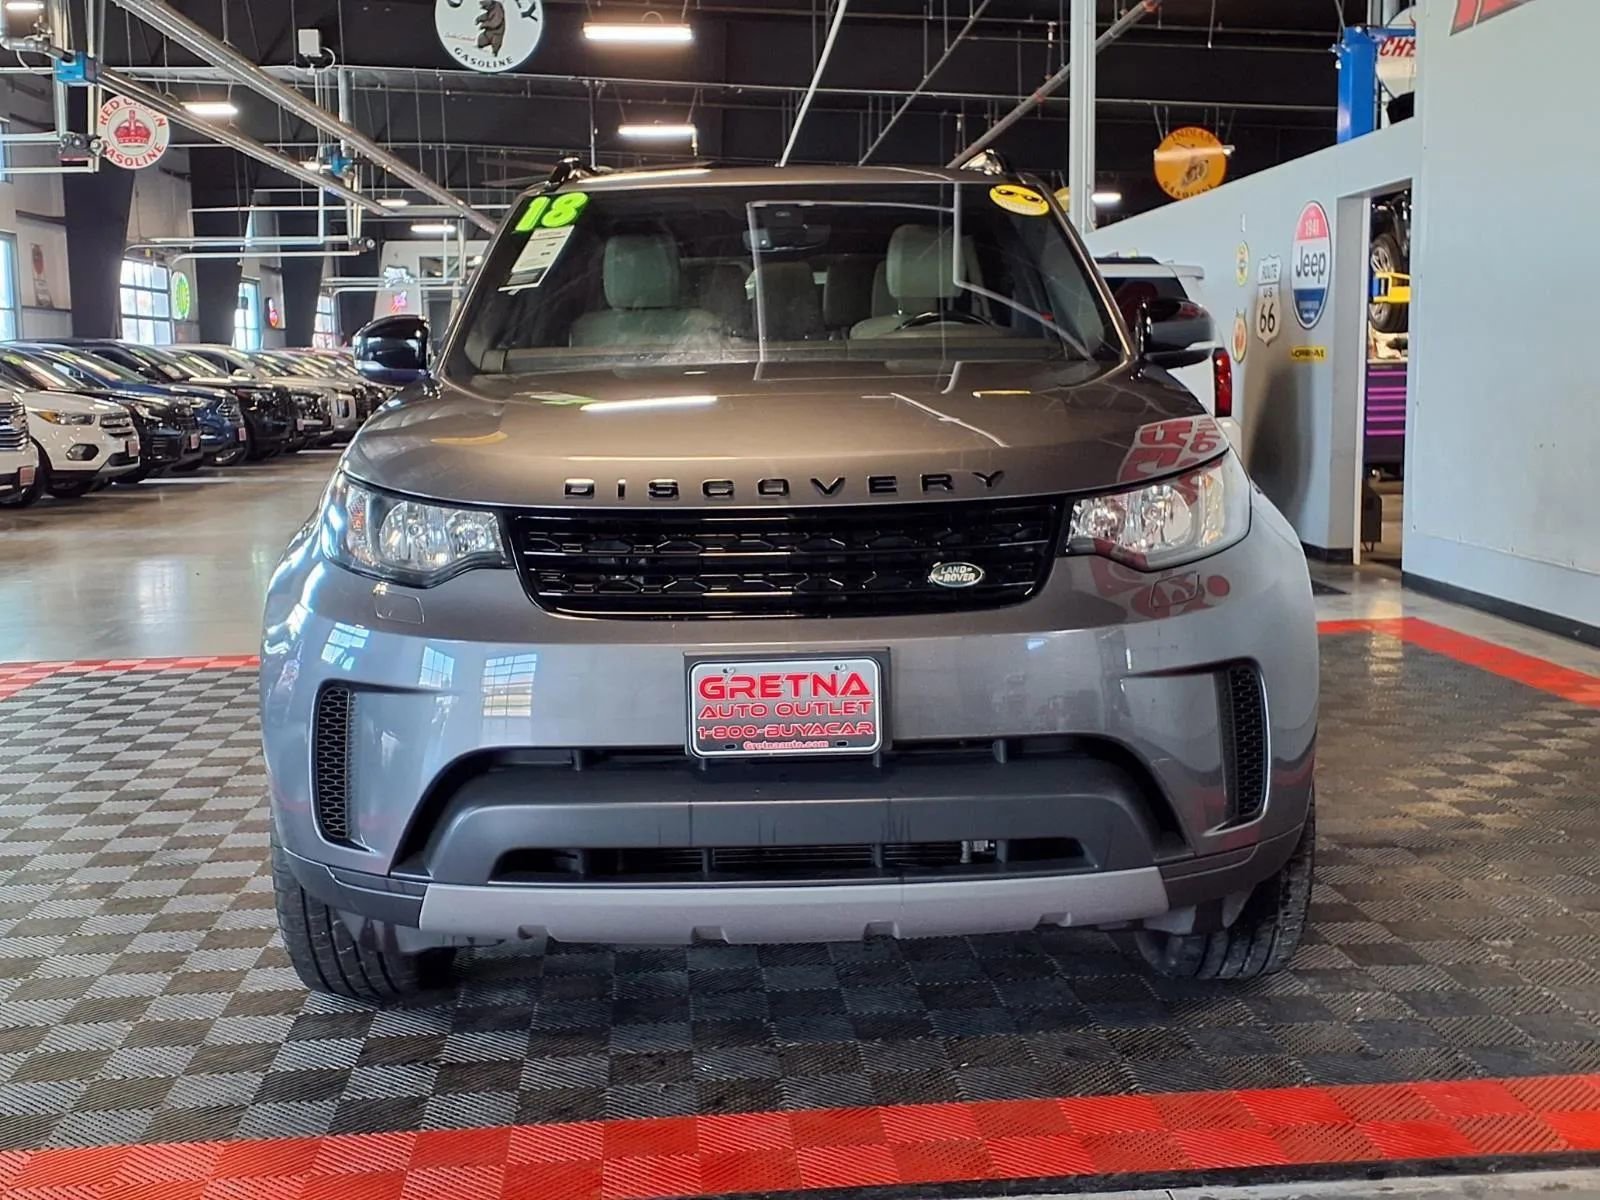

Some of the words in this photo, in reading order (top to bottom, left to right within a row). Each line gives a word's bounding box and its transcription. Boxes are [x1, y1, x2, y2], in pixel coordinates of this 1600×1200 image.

[454, 47, 513, 68] GASOLINE
[100, 99, 120, 125] RED
[514, 192, 589, 232] 18
[1261, 263, 1278, 281] ROUTE
[1296, 246, 1326, 284] Jeep
[1263, 287, 1273, 298] US
[1259, 302, 1276, 333] 66
[564, 470, 1004, 499] DISCOVERY
[698, 672, 872, 700] GRETNA
[698, 703, 768, 720] AUTO
[775, 700, 873, 718] OUTLET
[697, 722, 874, 740] 1-800-BUYACAR
[743, 740, 829, 750] Gretnaauto.com
